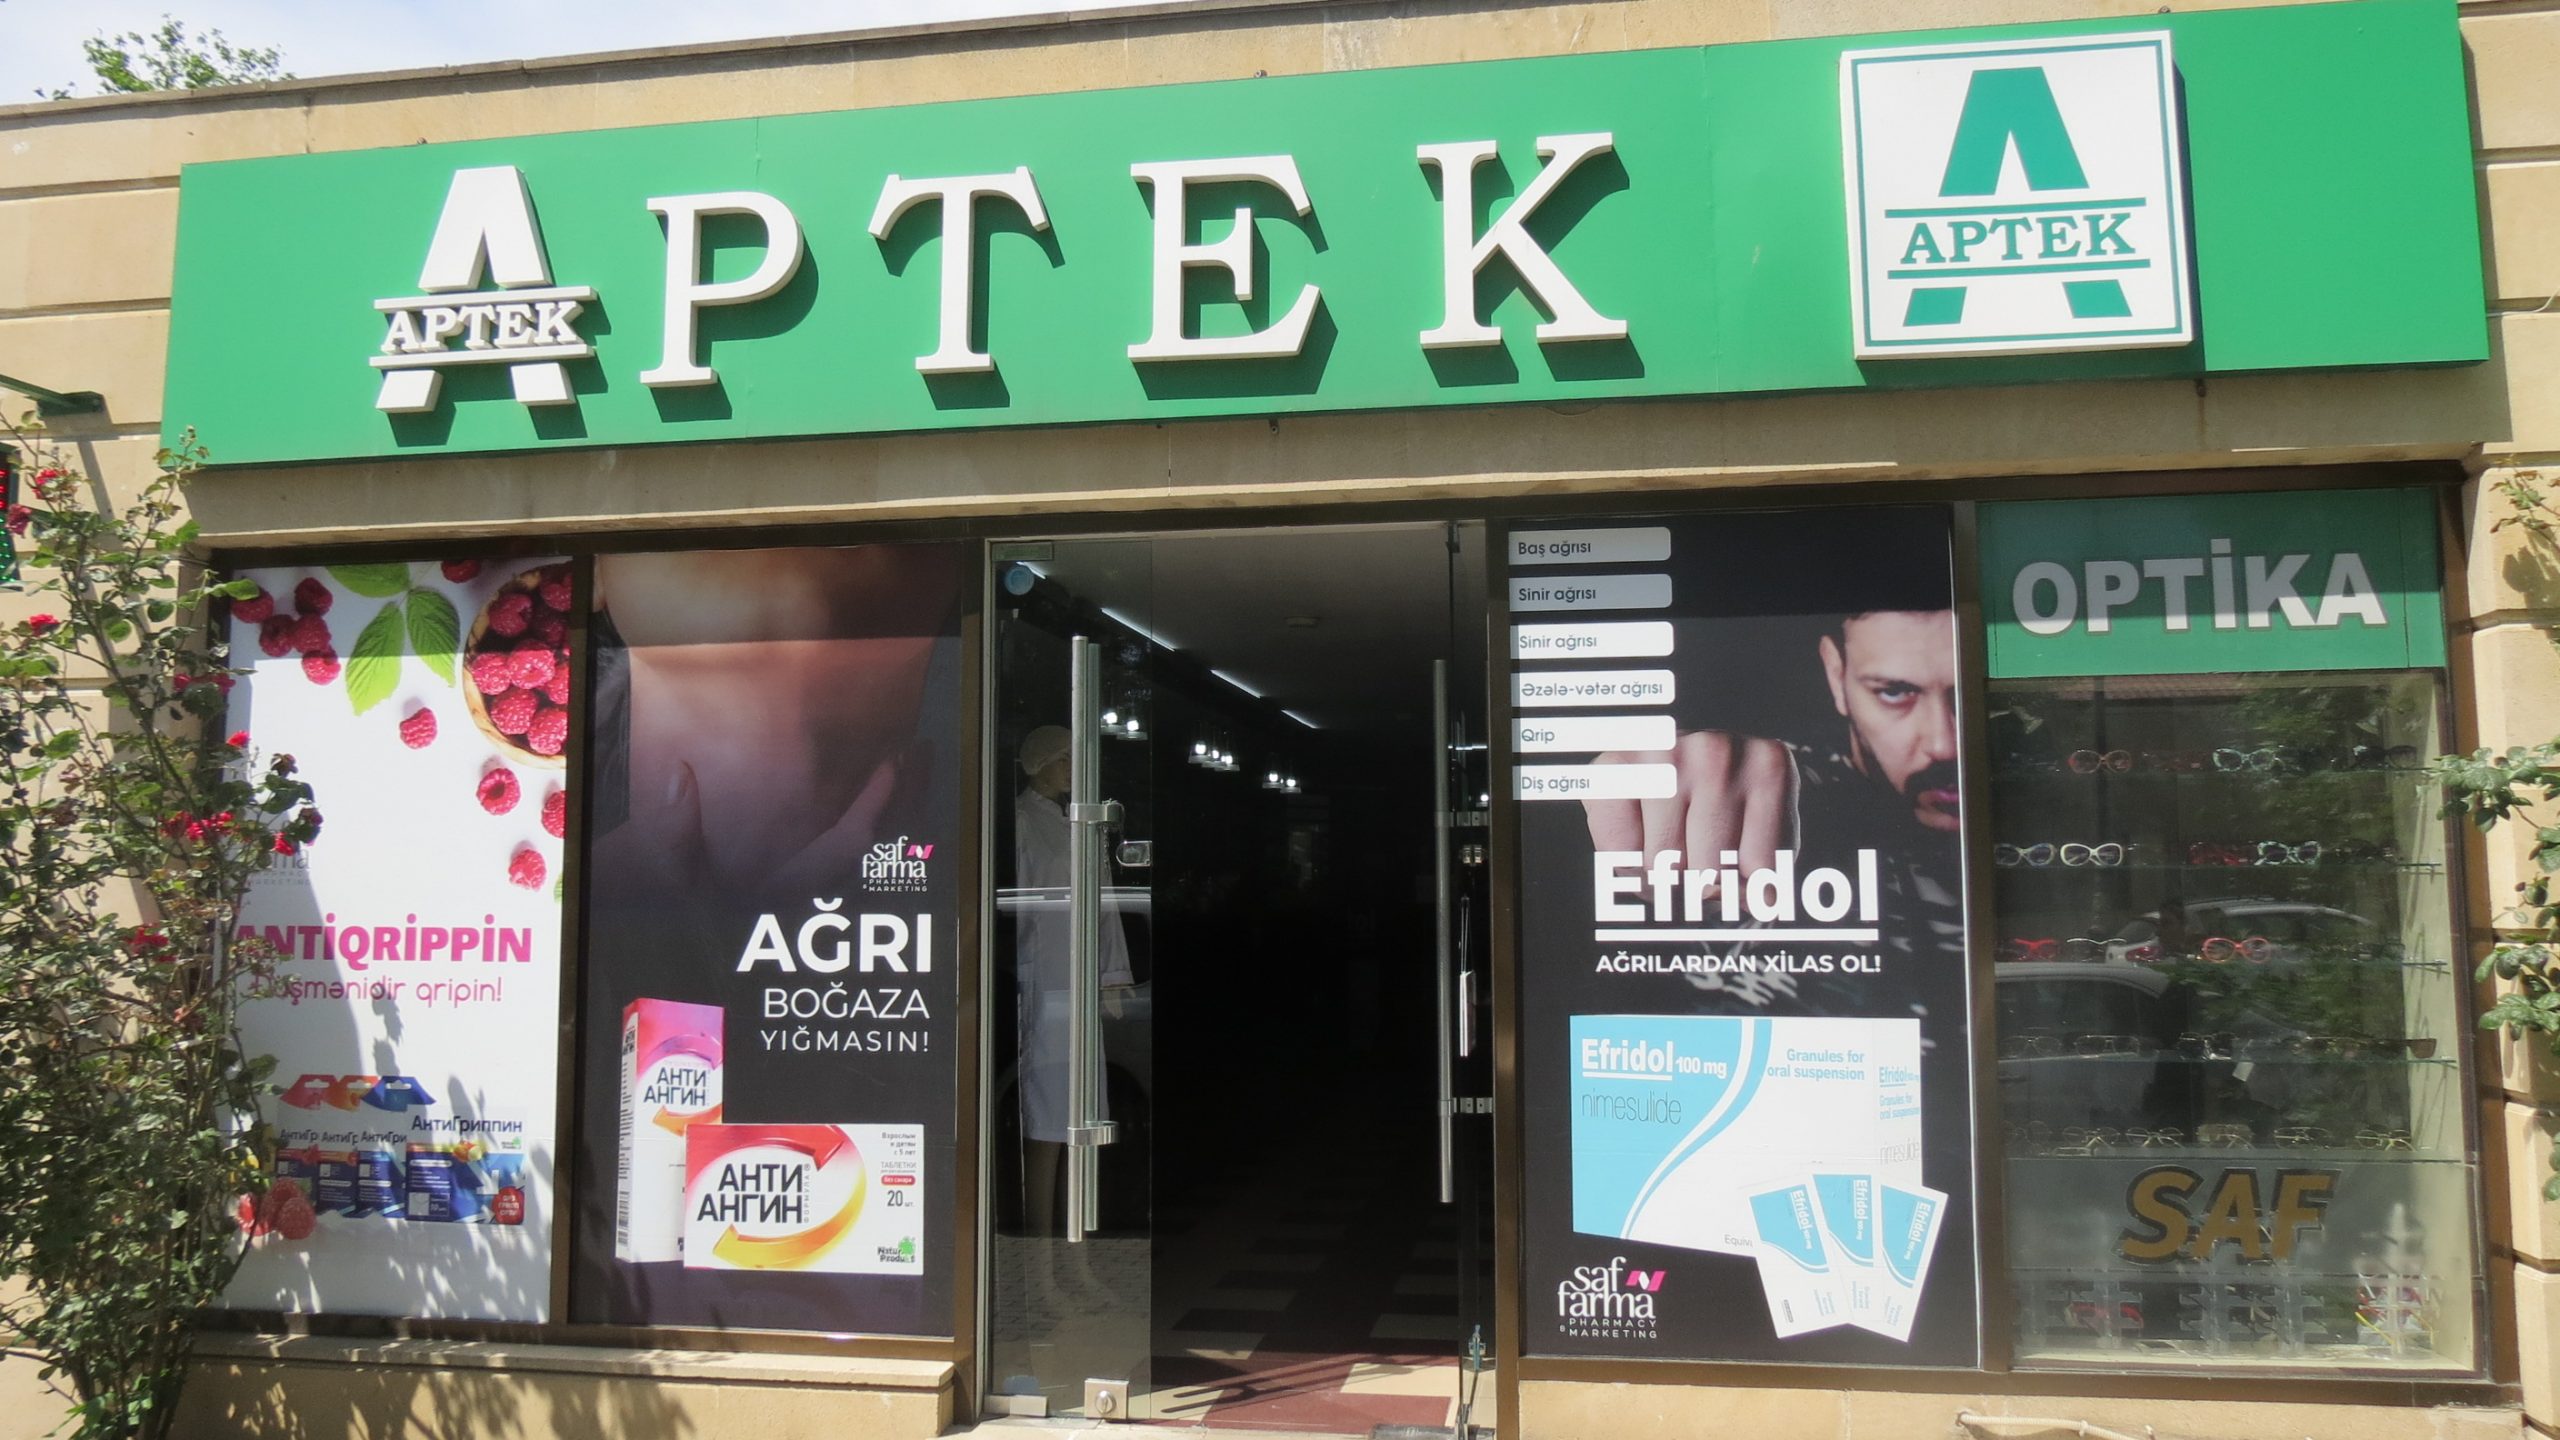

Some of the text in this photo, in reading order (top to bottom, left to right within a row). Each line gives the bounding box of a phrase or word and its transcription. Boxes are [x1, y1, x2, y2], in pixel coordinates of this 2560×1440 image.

[1899, 212, 2136, 265] APTEK
[380, 301, 586, 355] APTEK
[1518, 540, 1591, 557] Baş ağrısı
[1519, 587, 1596, 603] Sinir ağrısı
[2011, 538, 2388, 635] OPTİKA
[1519, 635, 1597, 650] Sinir ağrısı
[1521, 682, 1663, 697] Əzələ-vətər ağrısı
[1521, 728, 1555, 744] Qrip
[1521, 776, 1590, 793] Diş ağrısı
[873, 835, 909, 861] saf
[862, 853, 927, 878] farma
[1594, 849, 1879, 923] Efridol
[736, 897, 932, 973] AĞRI
[1596, 950, 1881, 973] AĞRILARDAN XİLAS OL!
[416, 976, 503, 1008] qripin!
[764, 981, 930, 1019] BOĞAZA
[760, 1025, 929, 1052] YIĞMASIN!
[1582, 1038, 1728, 1079] Efridol 100 mg
[1786, 1048, 1865, 1063] Granules for
[656, 1067, 706, 1087] АНТИ
[1767, 1065, 1865, 1081] oral suspension
[643, 1085, 706, 1106] АНГИН
[1581, 1087, 1682, 1125] nimesulide
[718, 1163, 803, 1192] АНТИ
[696, 1193, 803, 1224] АНГИН
[887, 1190, 904, 1207] 20
[1792, 1189, 1813, 1230] Efridol
[1856, 1179, 1868, 1219] Efridol
[1911, 1201, 1931, 1243] Efridol
[2113, 1164, 2342, 1266] SAF
[1574, 1256, 1627, 1292] saf
[1557, 1280, 1656, 1318] farma
[1569, 1318, 1657, 1328] PHARMACY
[1569, 1329, 1657, 1339] MARKETING
